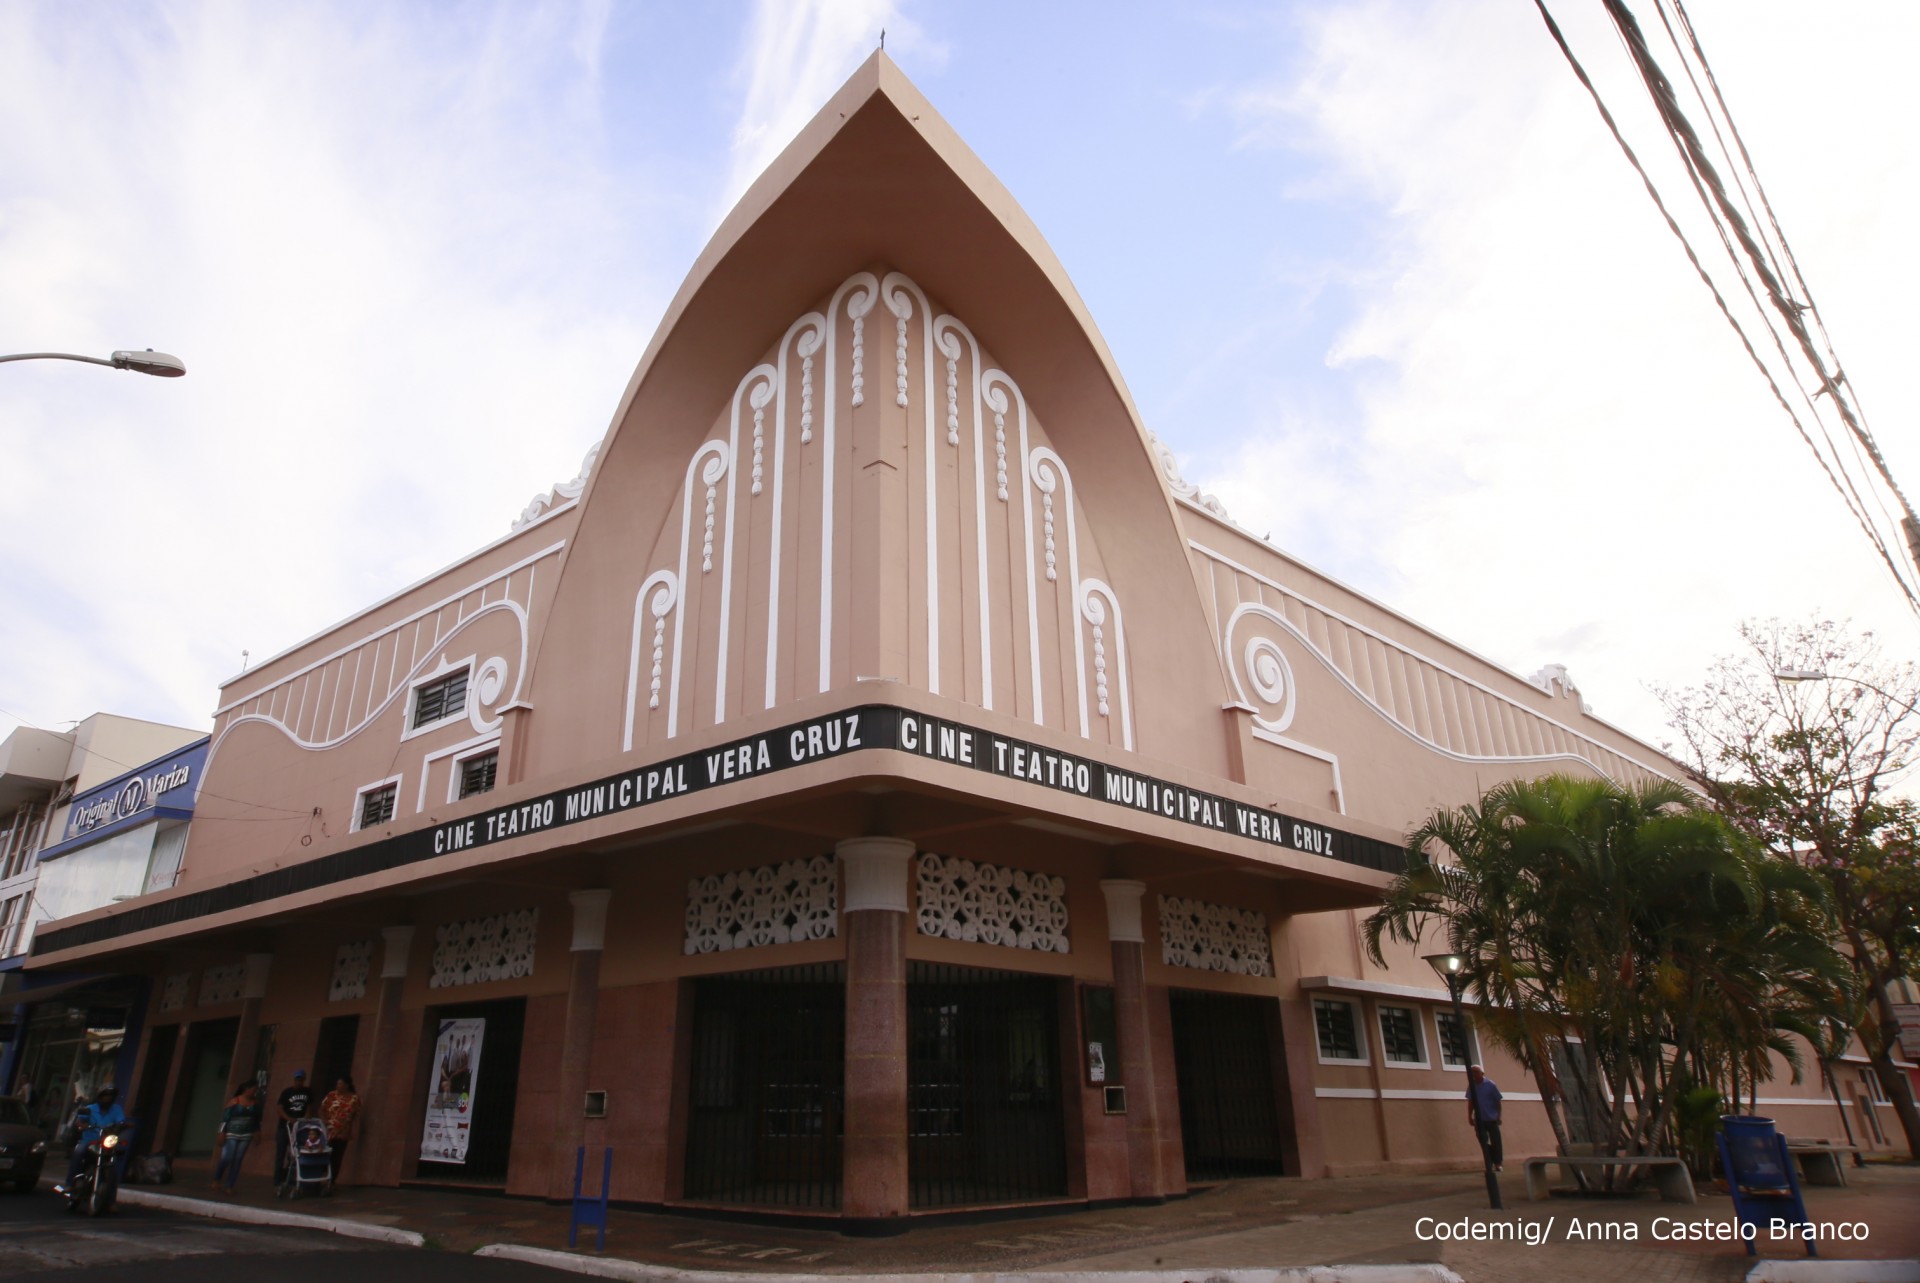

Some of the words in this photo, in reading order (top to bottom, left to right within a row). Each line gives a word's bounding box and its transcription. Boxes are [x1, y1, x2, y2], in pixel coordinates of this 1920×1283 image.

[74, 791, 119, 829] Original
[142, 764, 190, 801] Mariza
[434, 821, 475, 854] CINE
[487, 799, 554, 841] TEATRO
[565, 764, 688, 821] MUNICIPAL
[706, 739, 771, 784] VERA
[790, 714, 861, 762] CRUZ
[901, 717, 972, 764] CINE
[994, 740, 1090, 794] TEATRO
[1106, 773, 1225, 828] MUNICIPAL
[1236, 808, 1282, 843] VERA
[1293, 824, 1333, 856] CRUZ
